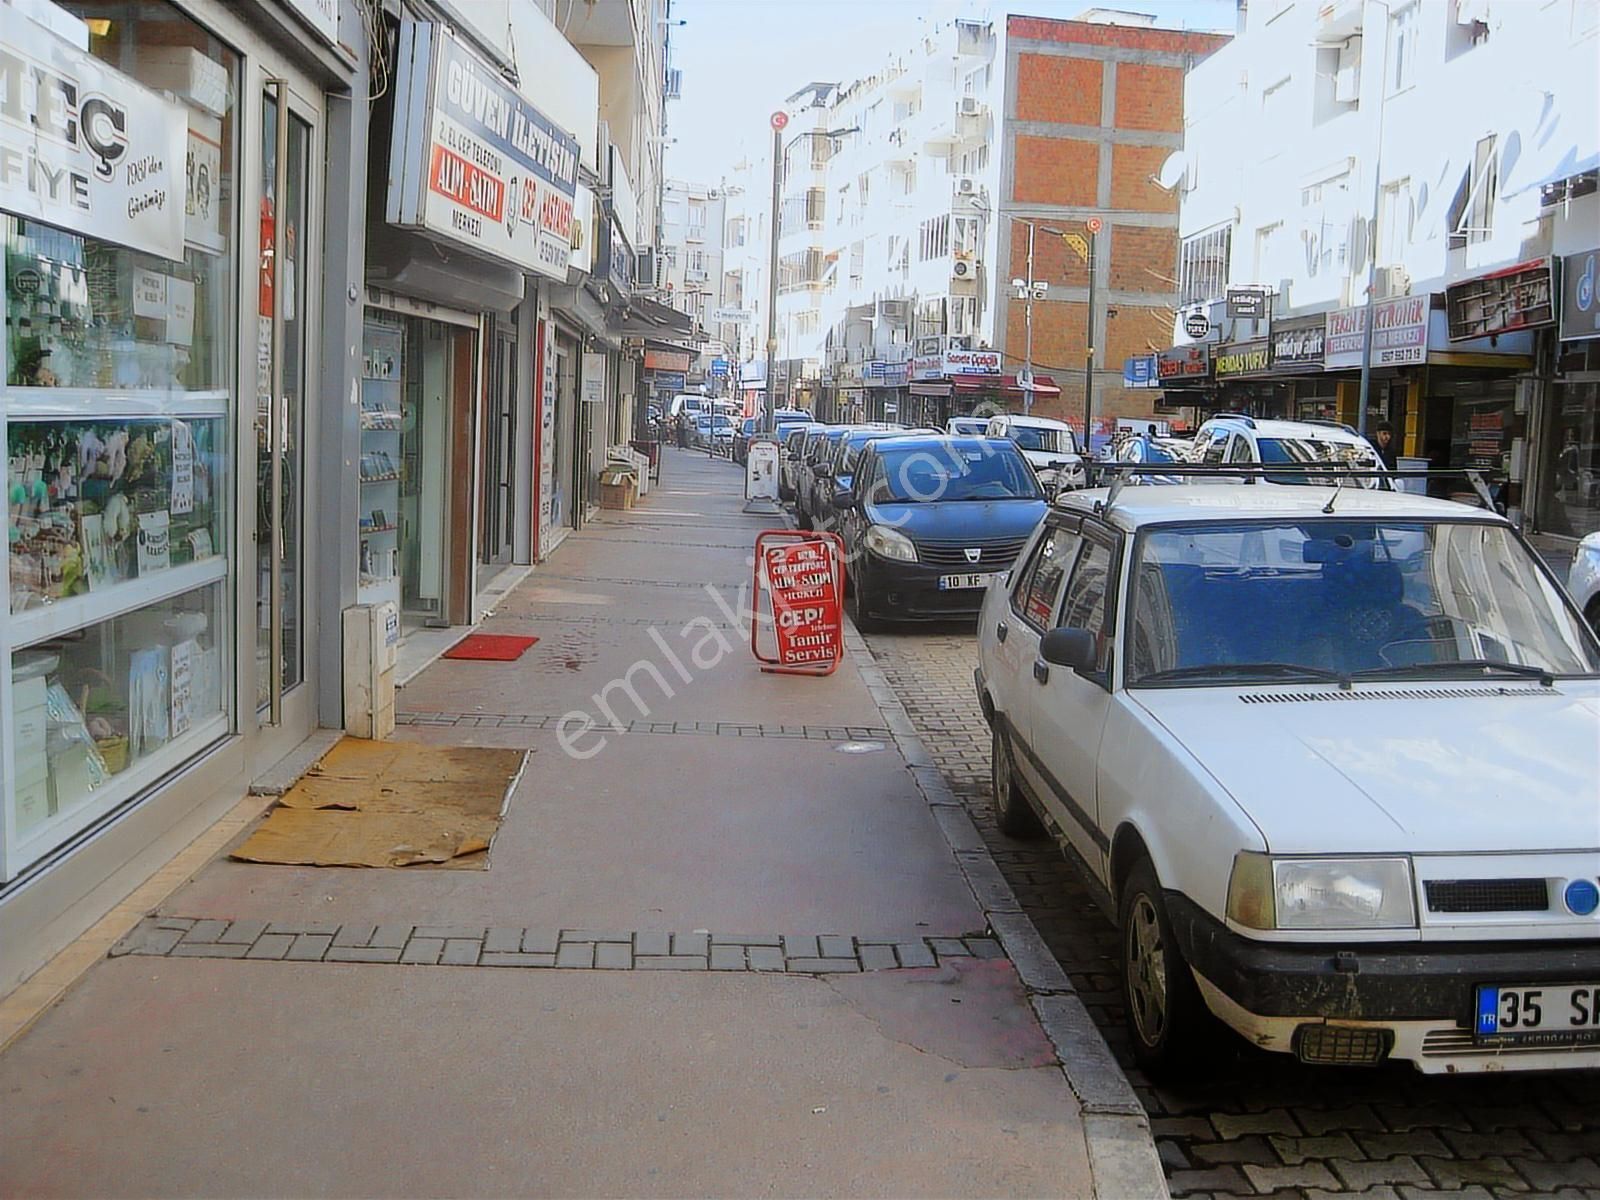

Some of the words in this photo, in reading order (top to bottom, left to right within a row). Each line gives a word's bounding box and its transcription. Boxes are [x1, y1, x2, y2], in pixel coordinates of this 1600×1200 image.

[447, 60, 510, 140] GÜVEN
[511, 102, 576, 185] İLETİŞİM
[452, 208, 482, 238] MERKEZİ
[947, 576, 959, 587] 10
[789, 632, 833, 648] Tamir
[785, 645, 838, 662] Servisi
[1482, 1013, 1496, 1025] TR
[1499, 990, 1543, 1028] 35
